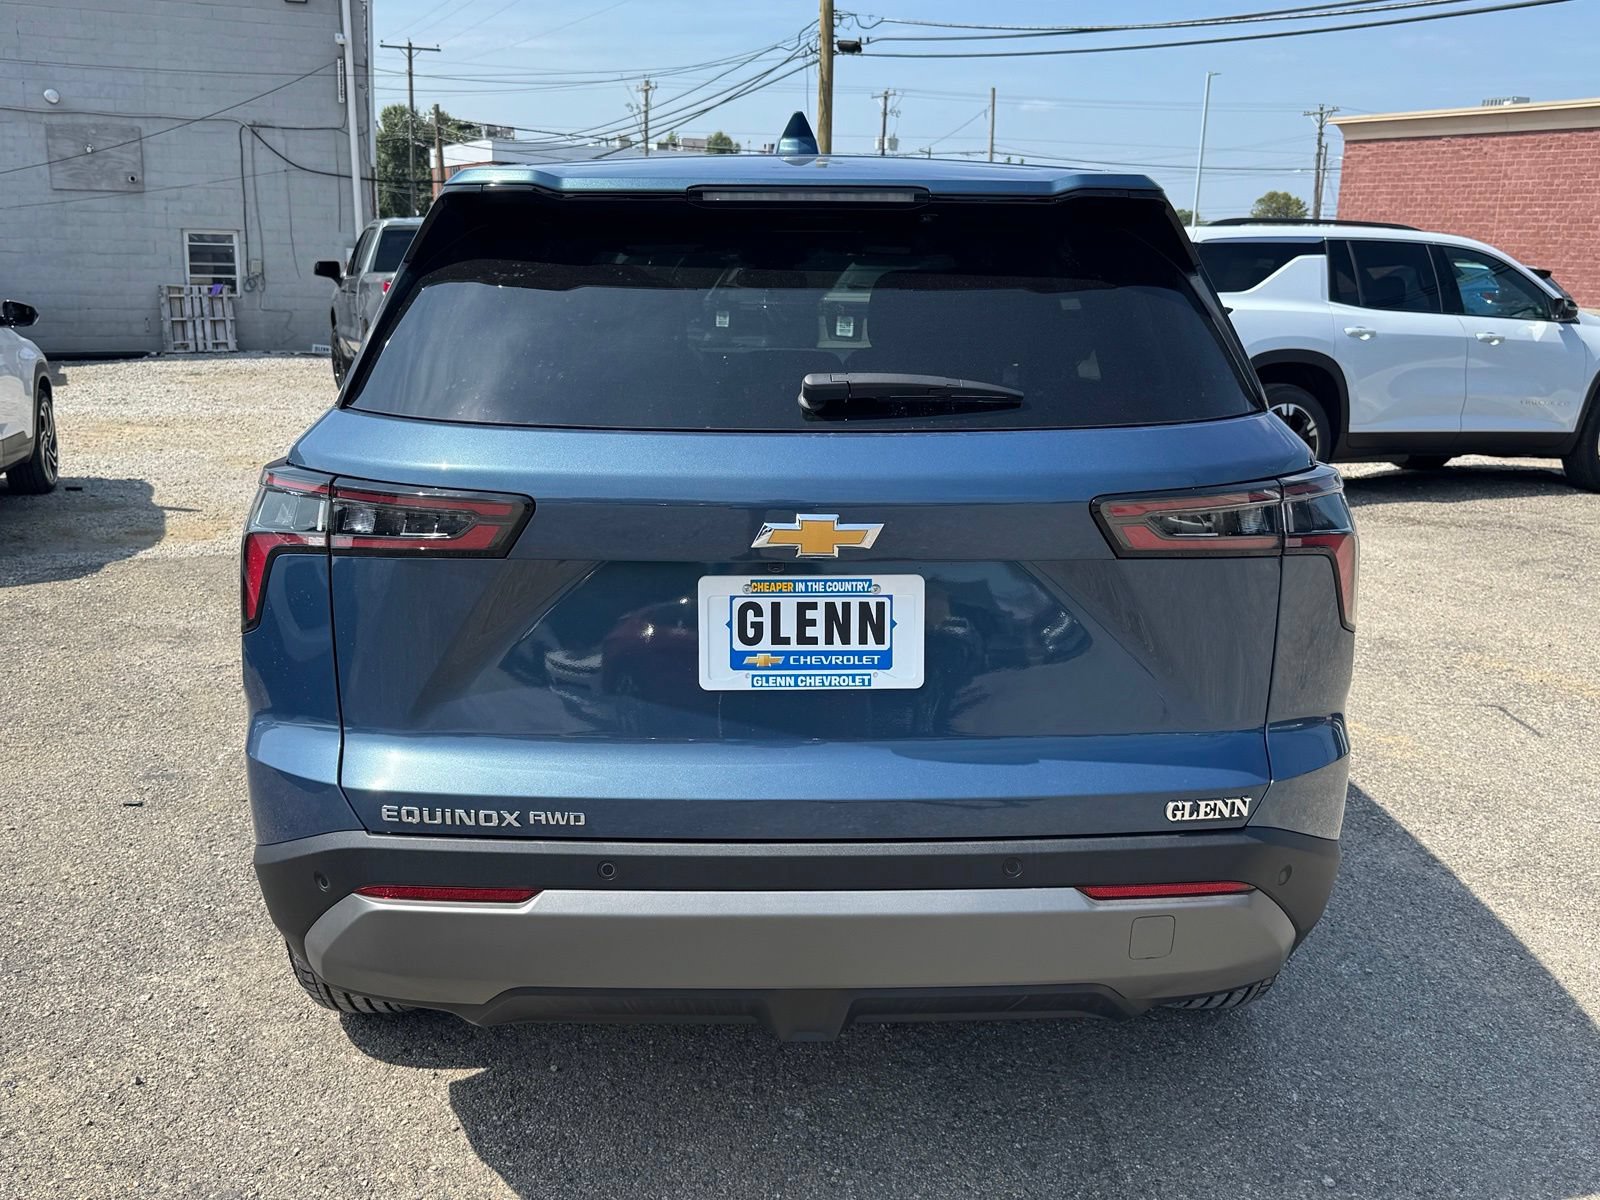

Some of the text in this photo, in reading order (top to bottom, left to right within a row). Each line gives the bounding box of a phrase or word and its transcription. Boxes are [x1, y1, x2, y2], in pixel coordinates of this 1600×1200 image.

[751, 580, 872, 593] CHEAPER IN THE COUNTRY.
[737, 600, 886, 647] GLENN
[789, 655, 881, 665] CHEVROLET
[753, 675, 871, 687] GLENN CHEVROLET
[381, 805, 586, 827] EQUINOX AWD
[1165, 797, 1252, 822] GLENN
